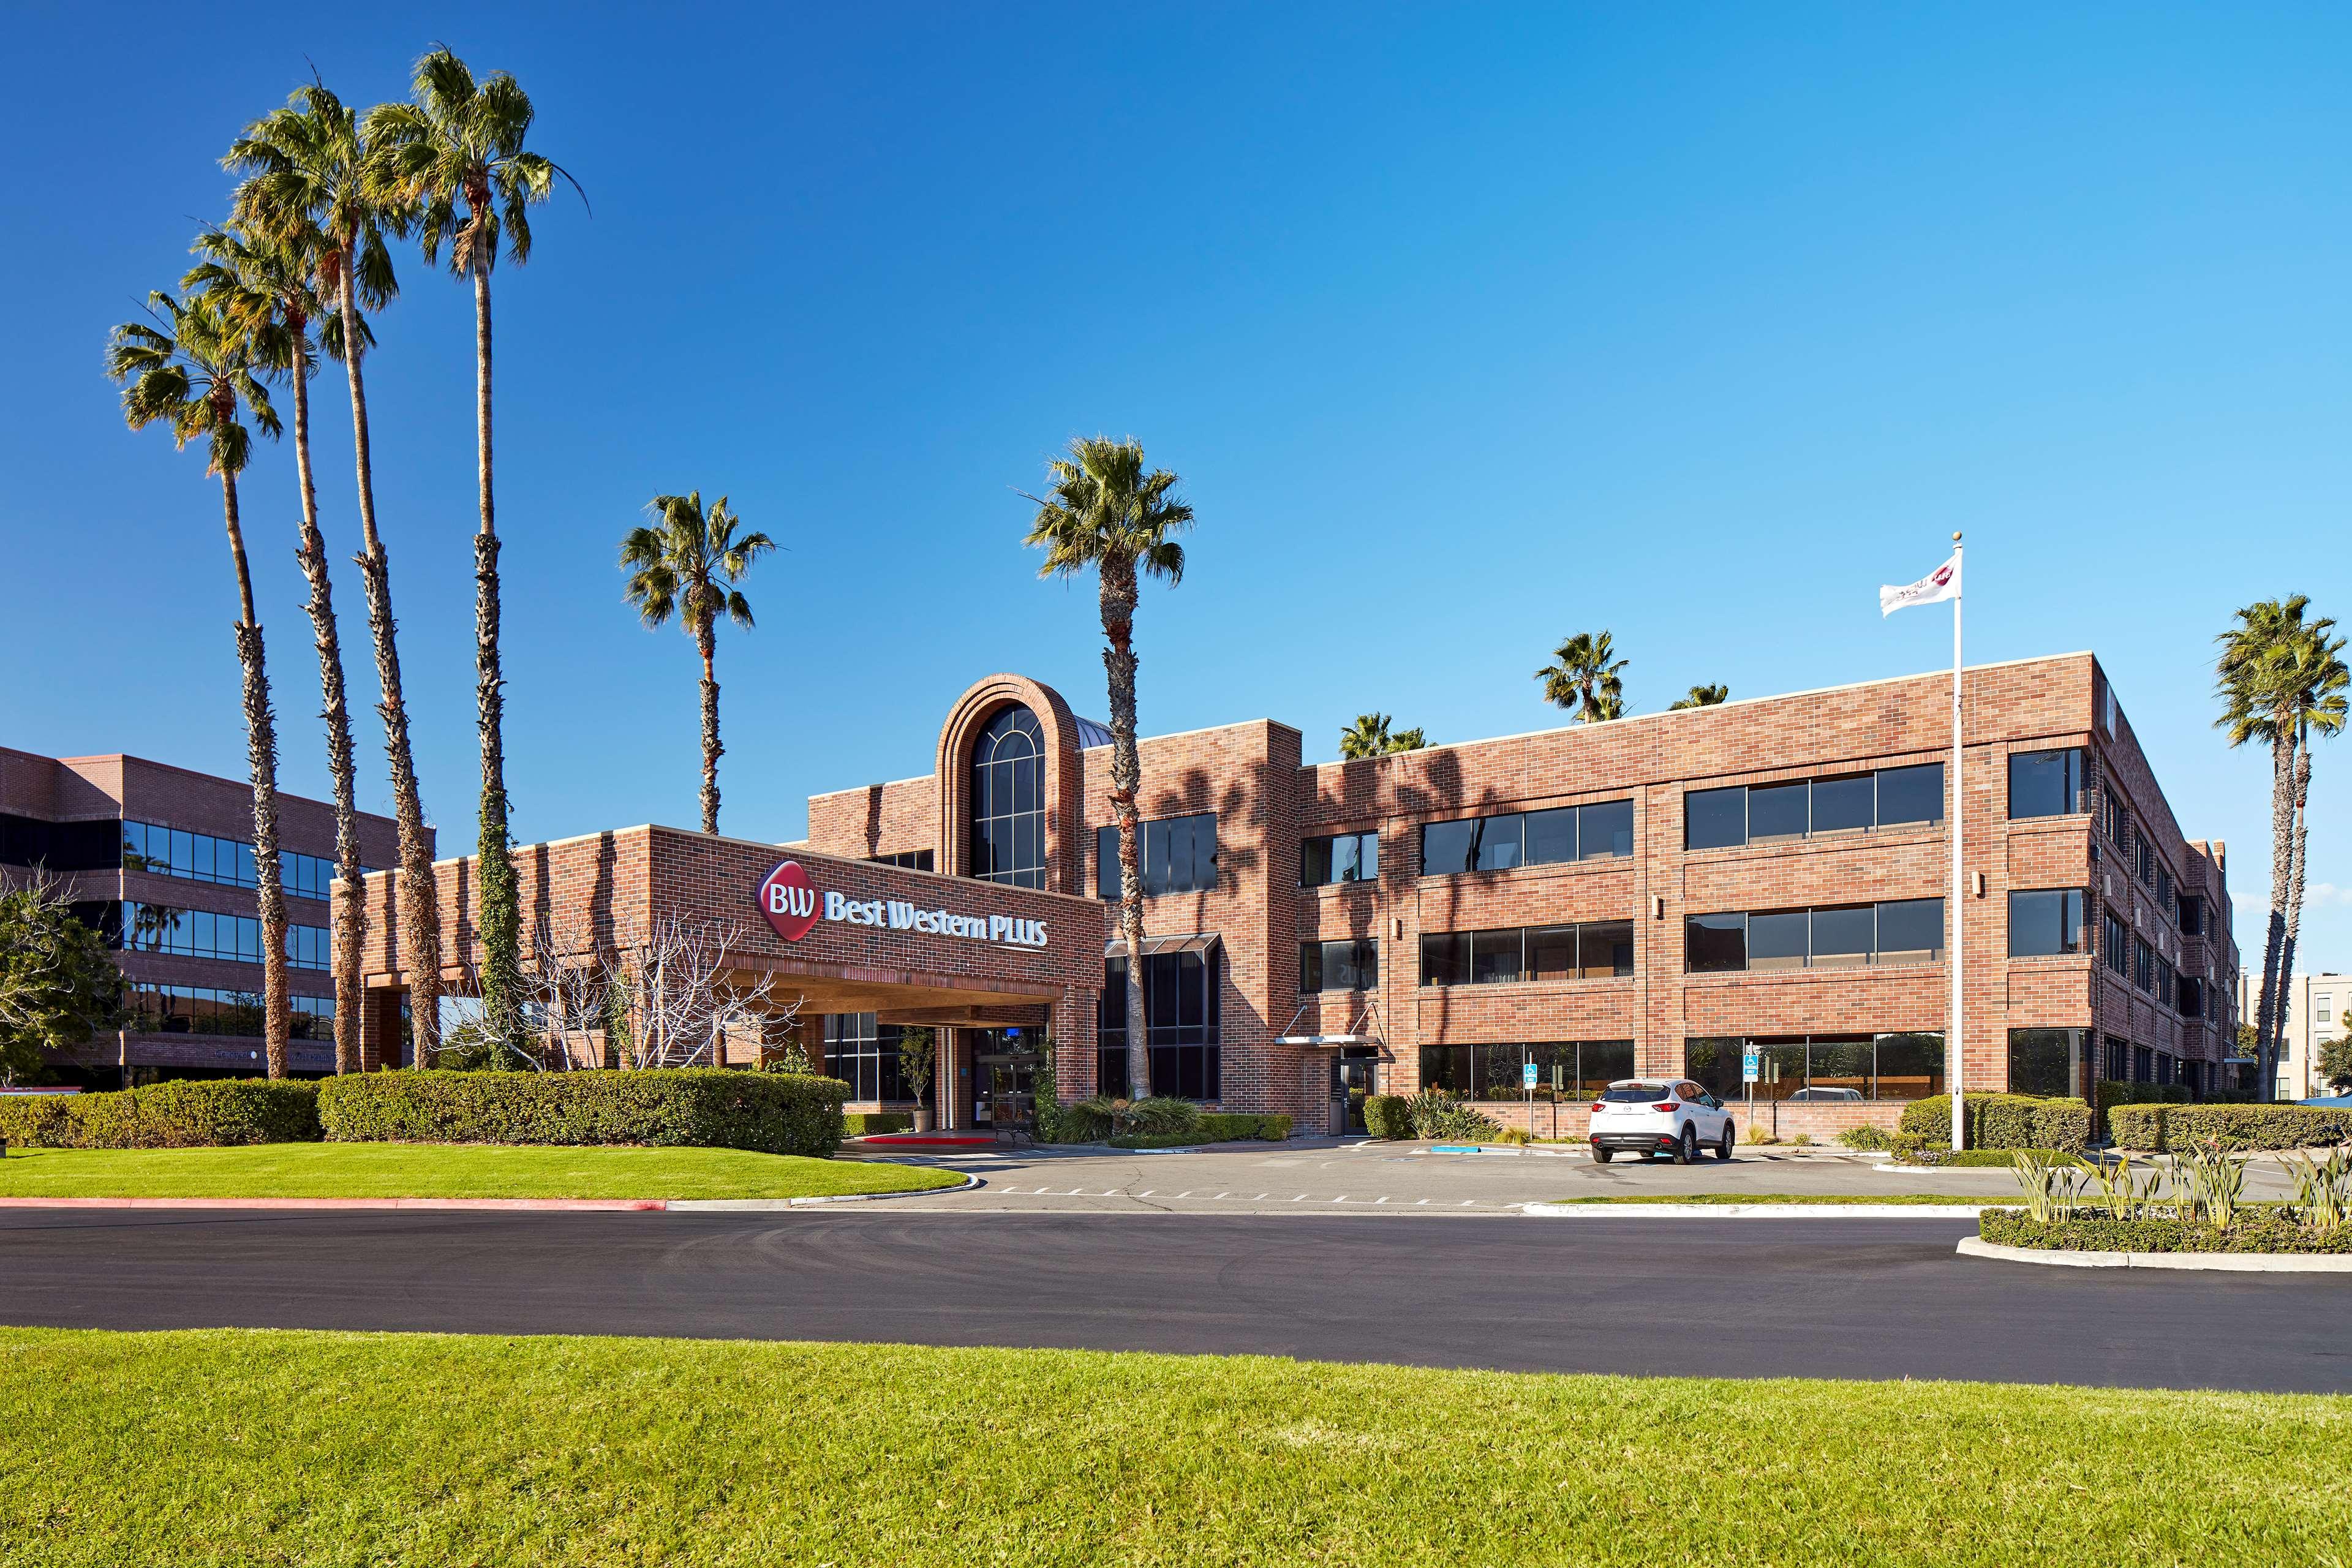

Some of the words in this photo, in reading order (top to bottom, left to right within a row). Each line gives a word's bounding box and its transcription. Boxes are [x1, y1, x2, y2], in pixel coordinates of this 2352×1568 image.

[769, 883, 815, 918] BW
[825, 891, 886, 927] Best
[887, 900, 987, 939] Western
[989, 915, 1047, 946] PLUS
